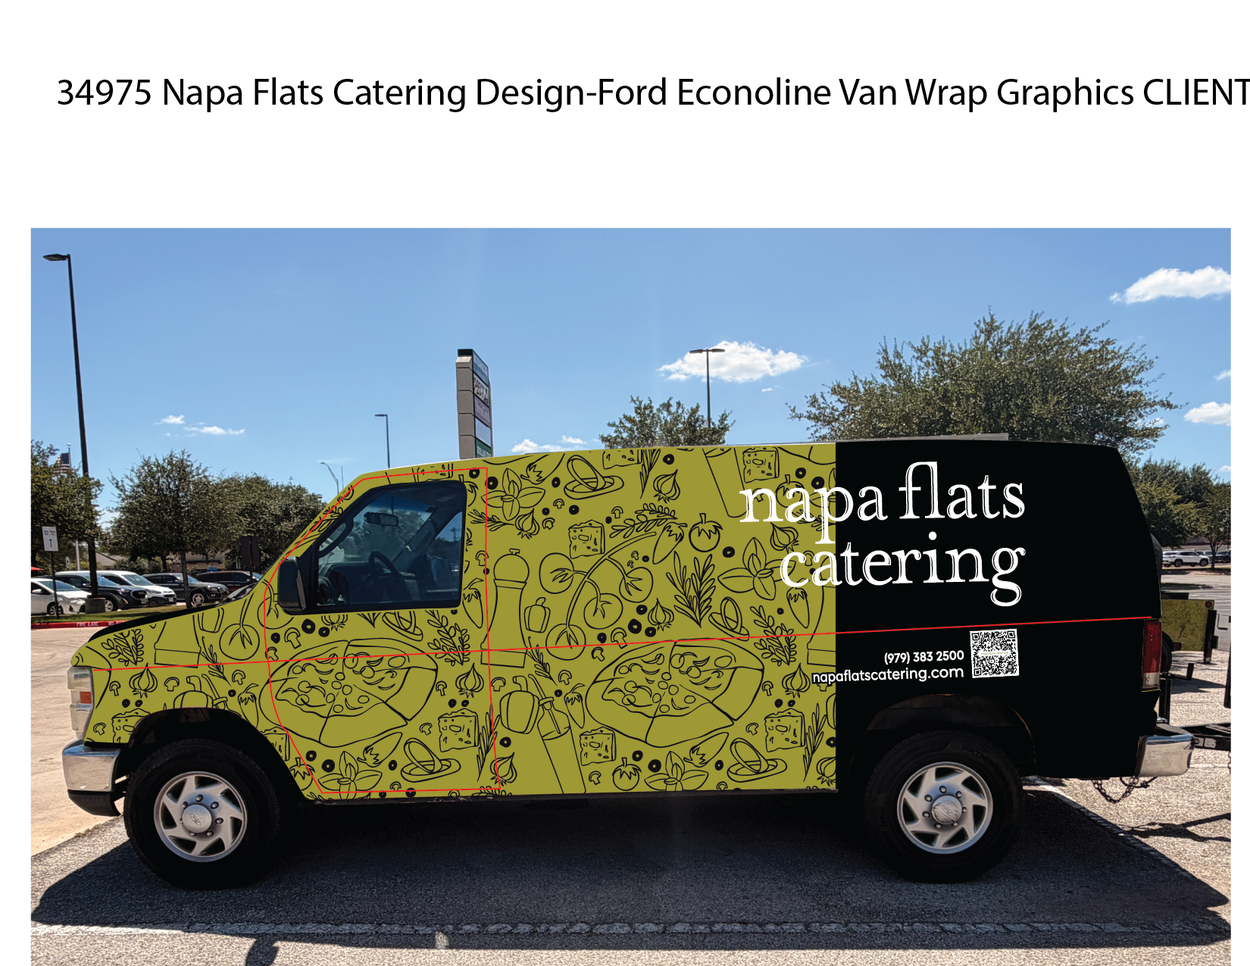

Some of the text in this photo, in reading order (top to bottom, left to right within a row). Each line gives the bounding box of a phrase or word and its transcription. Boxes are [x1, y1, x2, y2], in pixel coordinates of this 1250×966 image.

[739, 461, 1025, 546] napa flats
[779, 532, 1026, 607] catering
[812, 666, 965, 684] napaflatscatering.com
[884, 649, 965, 666] (979) 383 2500
